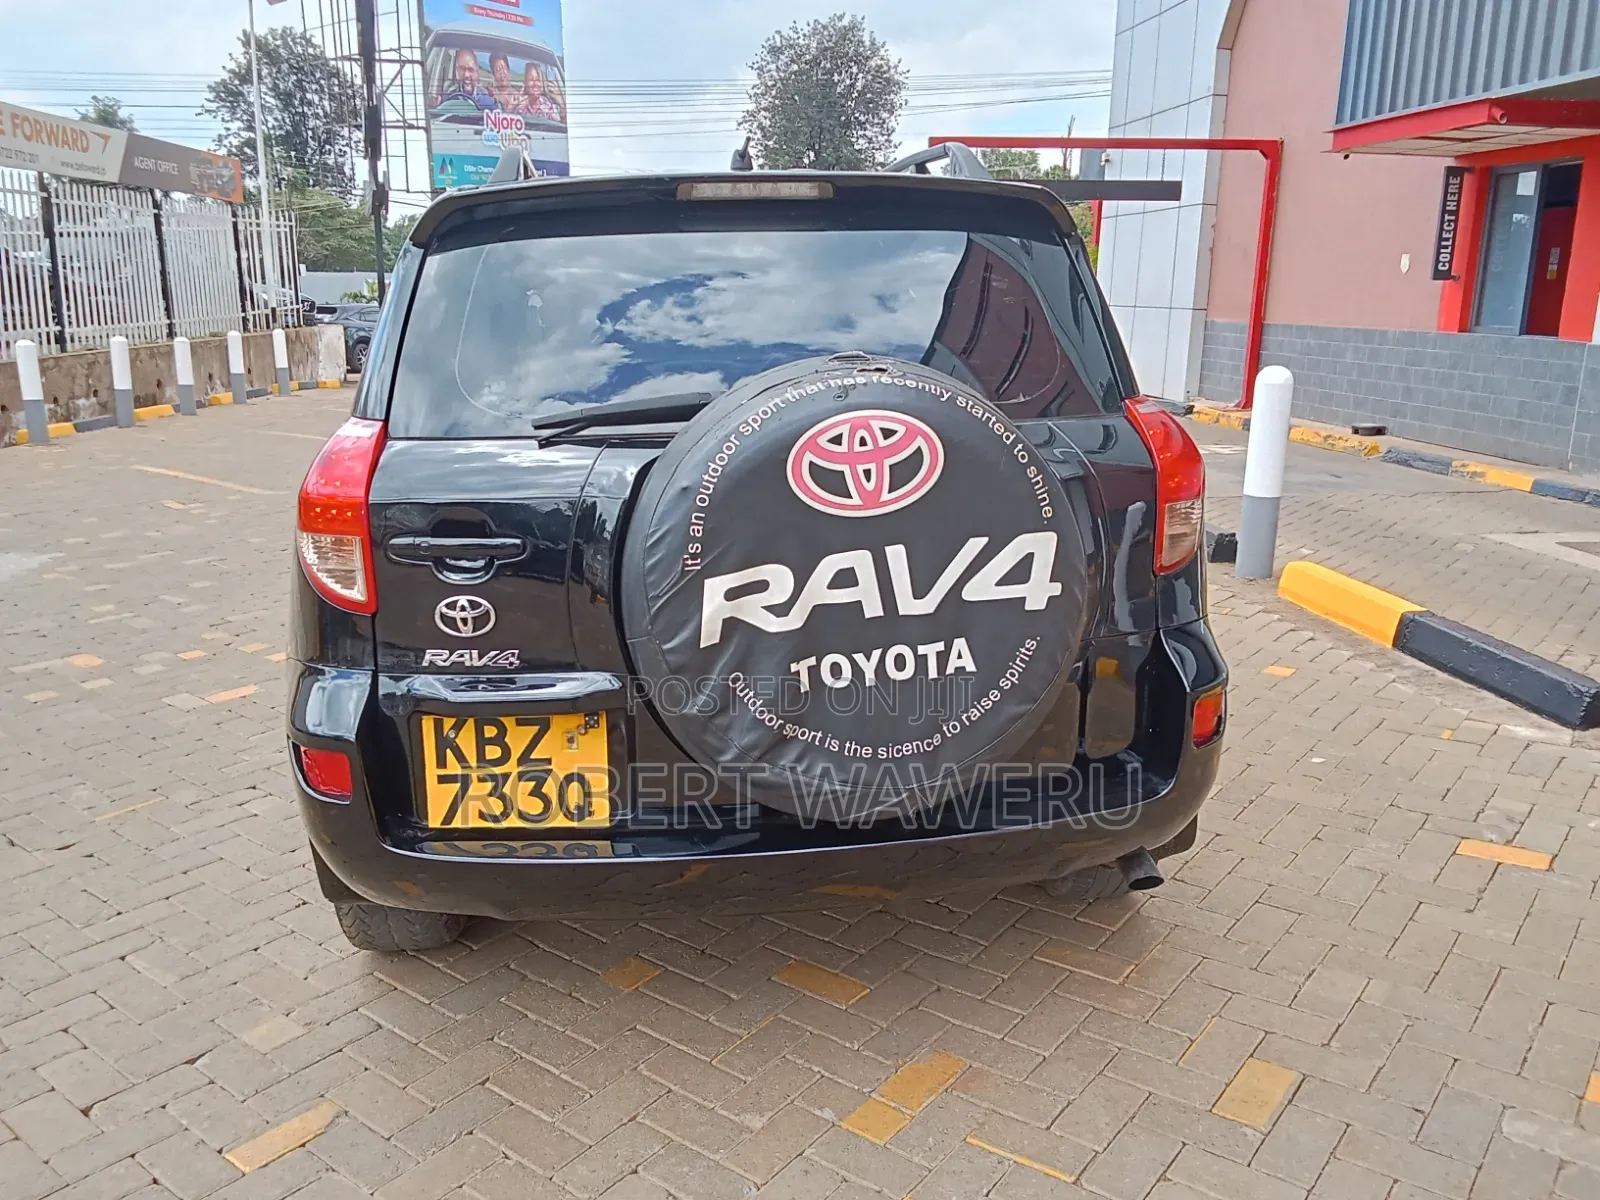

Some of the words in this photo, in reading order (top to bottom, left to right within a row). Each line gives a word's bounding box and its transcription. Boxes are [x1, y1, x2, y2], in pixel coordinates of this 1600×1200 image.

[10, 112, 90, 153] FORWARD
[484, 110, 525, 133] Njoro
[134, 156, 156, 171] AGENT
[157, 160, 180, 175] OFFICE
[477, 165, 494, 173] Chann
[1446, 176, 1461, 211] HERE
[1438, 213, 1456, 271] COLLECT
[785, 380, 827, 403] that
[873, 375, 952, 402] recently
[738, 394, 786, 436] sport
[955, 395, 1017, 445] started
[695, 433, 742, 507] outdoor
[1013, 442, 1029, 464] to
[1026, 465, 1054, 525] shine.
[689, 512, 706, 537] an
[683, 543, 702, 571] It's
[700, 530, 1063, 649] RAV4
[421, 649, 521, 669] RAV4
[790, 636, 978, 693] TOYOTA
[728, 671, 783, 731] Outdoor
[783, 722, 823, 747] sport
[824, 733, 840, 752] is
[843, 742, 873, 758] the
[877, 732, 942, 759] sicence
[941, 721, 961, 738] to
[961, 688, 1001, 727] raise
[999, 635, 1041, 690] spirits.
[433, 716, 553, 770] KBZ
[437, 768, 594, 826] 733Q
